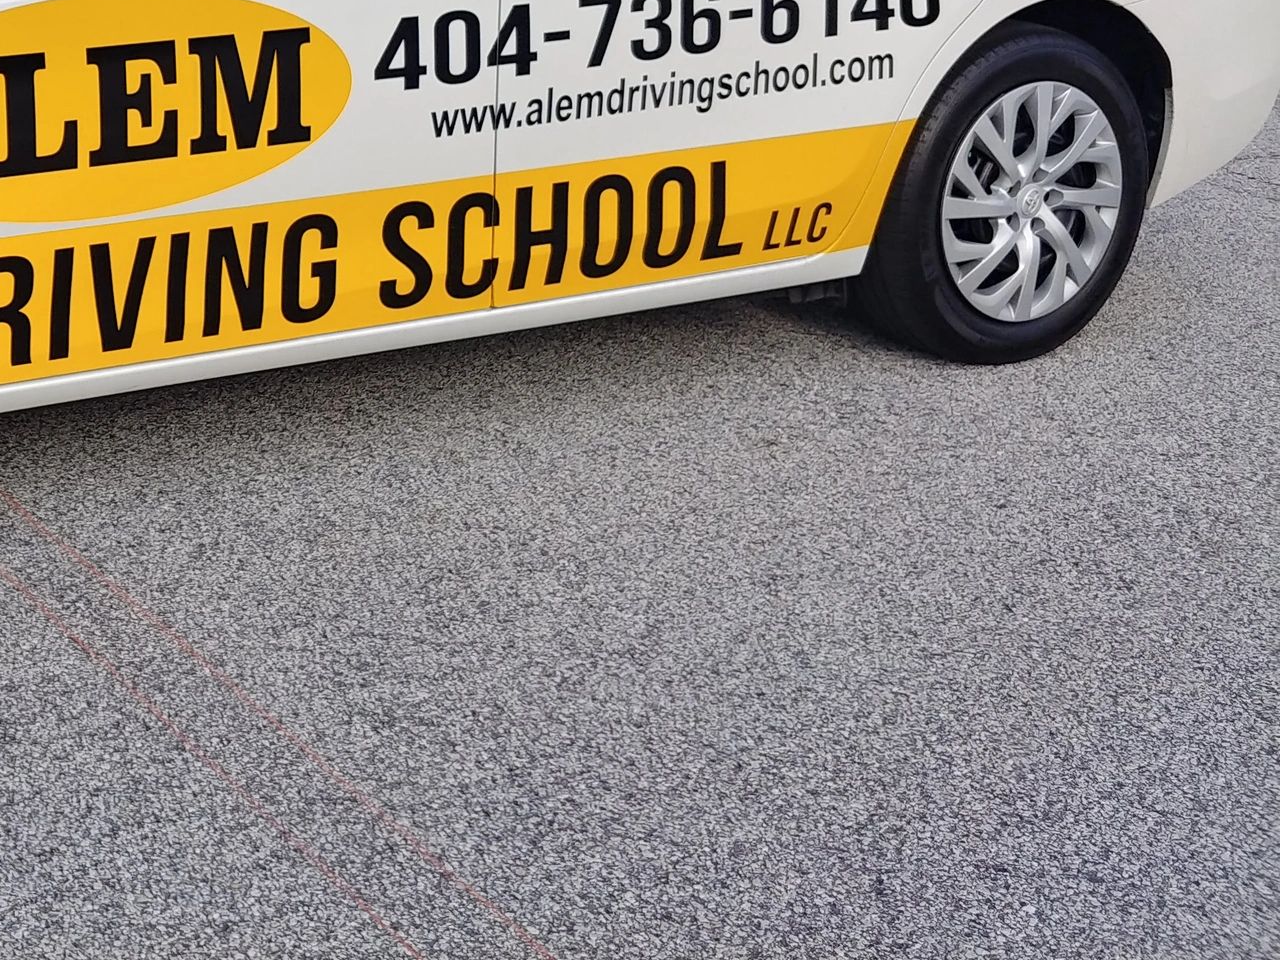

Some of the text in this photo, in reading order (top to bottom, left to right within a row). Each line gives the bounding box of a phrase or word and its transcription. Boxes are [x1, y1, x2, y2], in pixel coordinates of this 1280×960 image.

[431, 49, 894, 138] www.alemdrivingschool.com
[379, 160, 743, 311] SCHOOL
[761, 201, 833, 252] LLC
